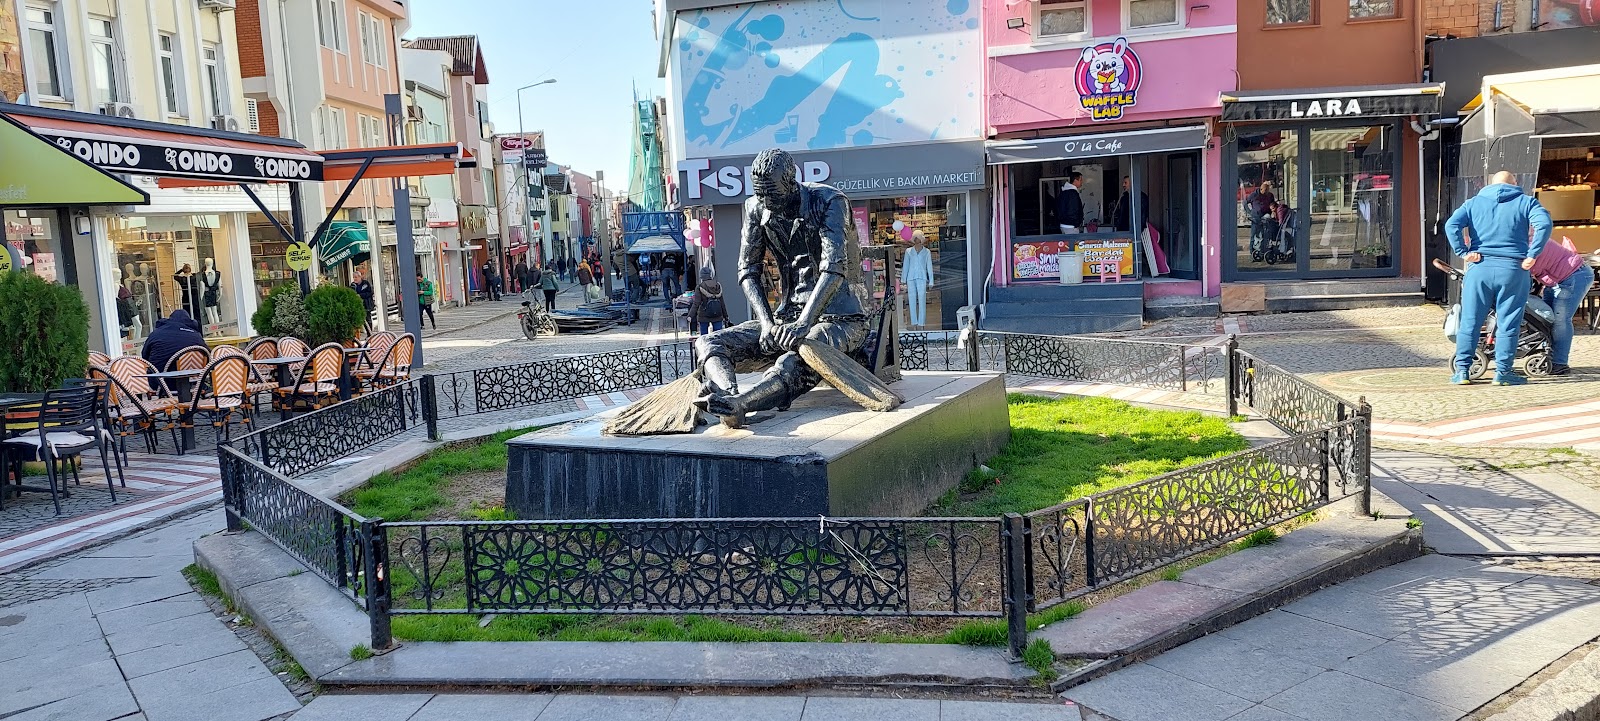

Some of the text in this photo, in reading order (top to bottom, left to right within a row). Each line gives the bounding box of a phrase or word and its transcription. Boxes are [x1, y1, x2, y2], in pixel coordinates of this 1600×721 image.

[1082, 92, 1134, 107] WAFFLE
[1094, 105, 1120, 118] LAB
[1291, 99, 1362, 117] LARA
[73, 140, 140, 166] ONDO
[1096, 139, 1122, 153] Cafe
[179, 150, 233, 174] ONDO
[265, 158, 311, 179] ONDO
[883, 177, 895, 188] VE
[898, 174, 930, 187] BAKIM
